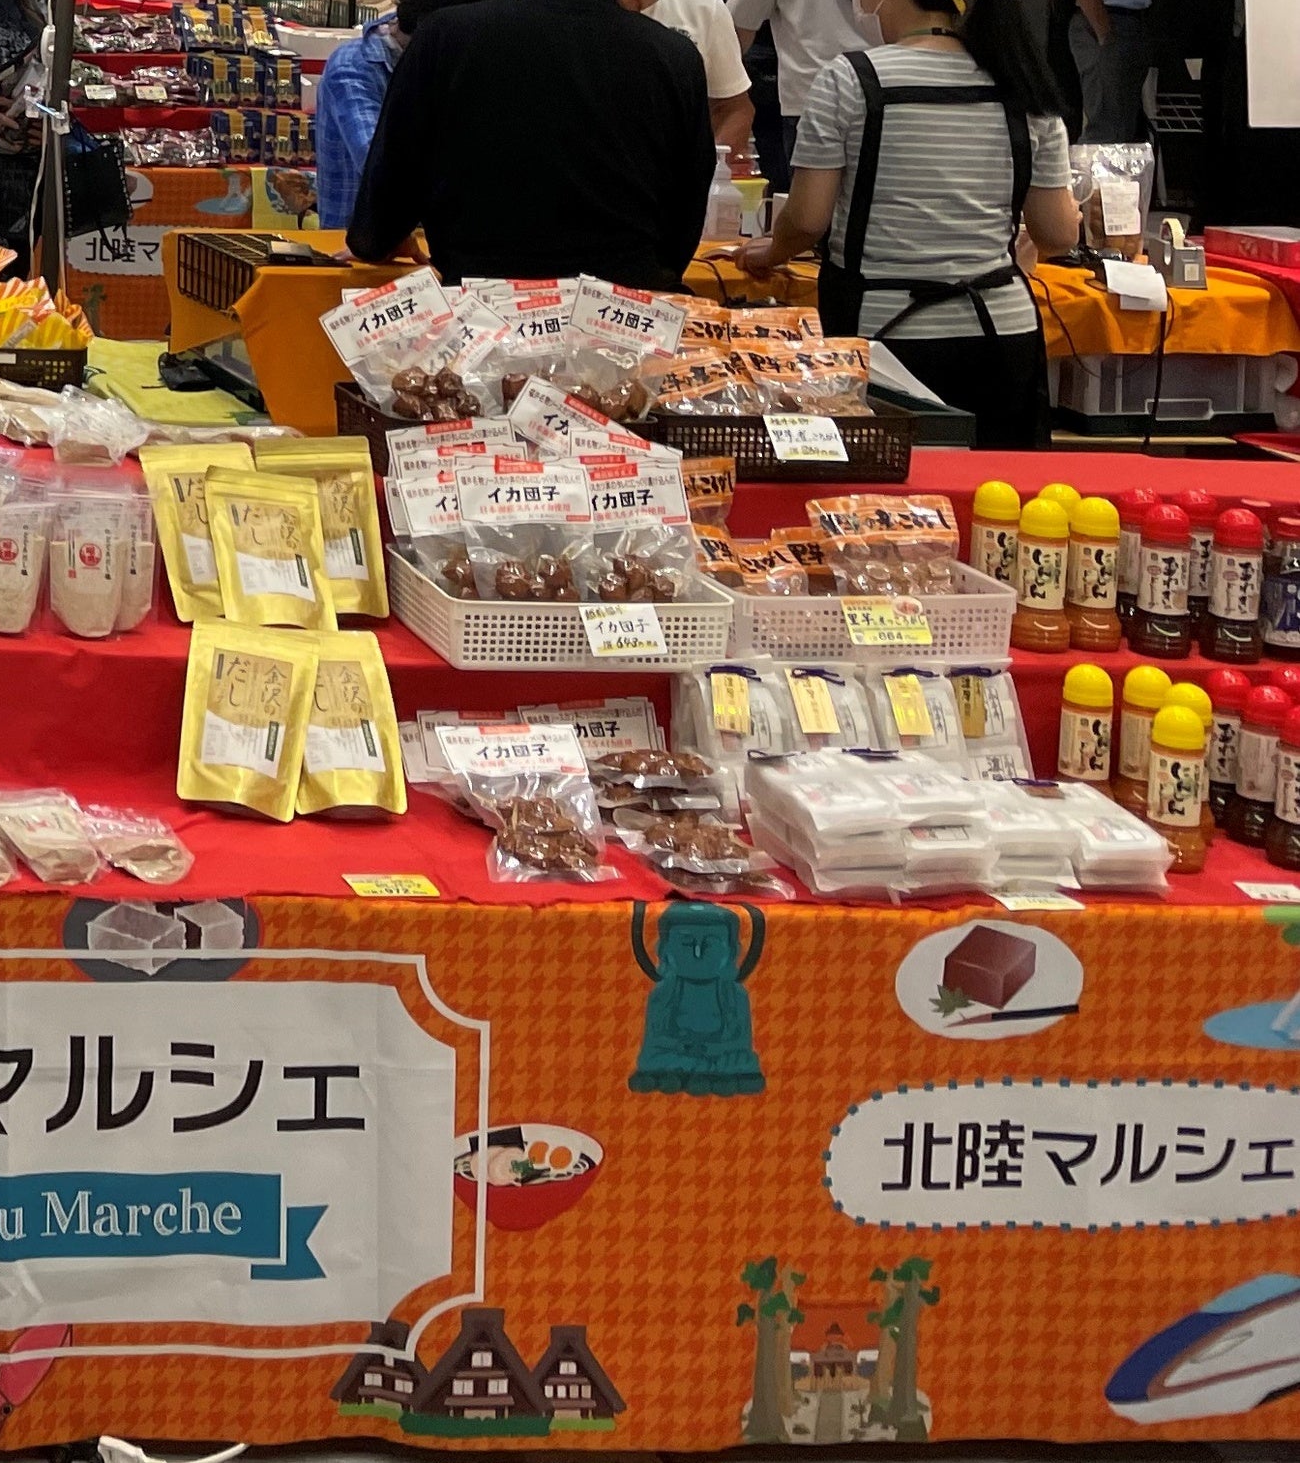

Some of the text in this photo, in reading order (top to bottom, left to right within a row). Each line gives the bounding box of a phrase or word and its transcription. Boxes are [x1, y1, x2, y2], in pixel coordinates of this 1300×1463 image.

[358, 298, 419, 334] イカ団子
[598, 305, 655, 333] イカ団子
[488, 486, 560, 504] イカ団子
[594, 619, 651, 635] イカ団子
[227, 656, 250, 707] だし
[261, 664, 288, 716] 金沢の
[339, 665, 366, 714] 金沢の
[476, 743, 551, 761] イカ団子
[881, 1118, 1296, 1193] 北陸マルシェ
[40, 1188, 244, 1238] Marche
